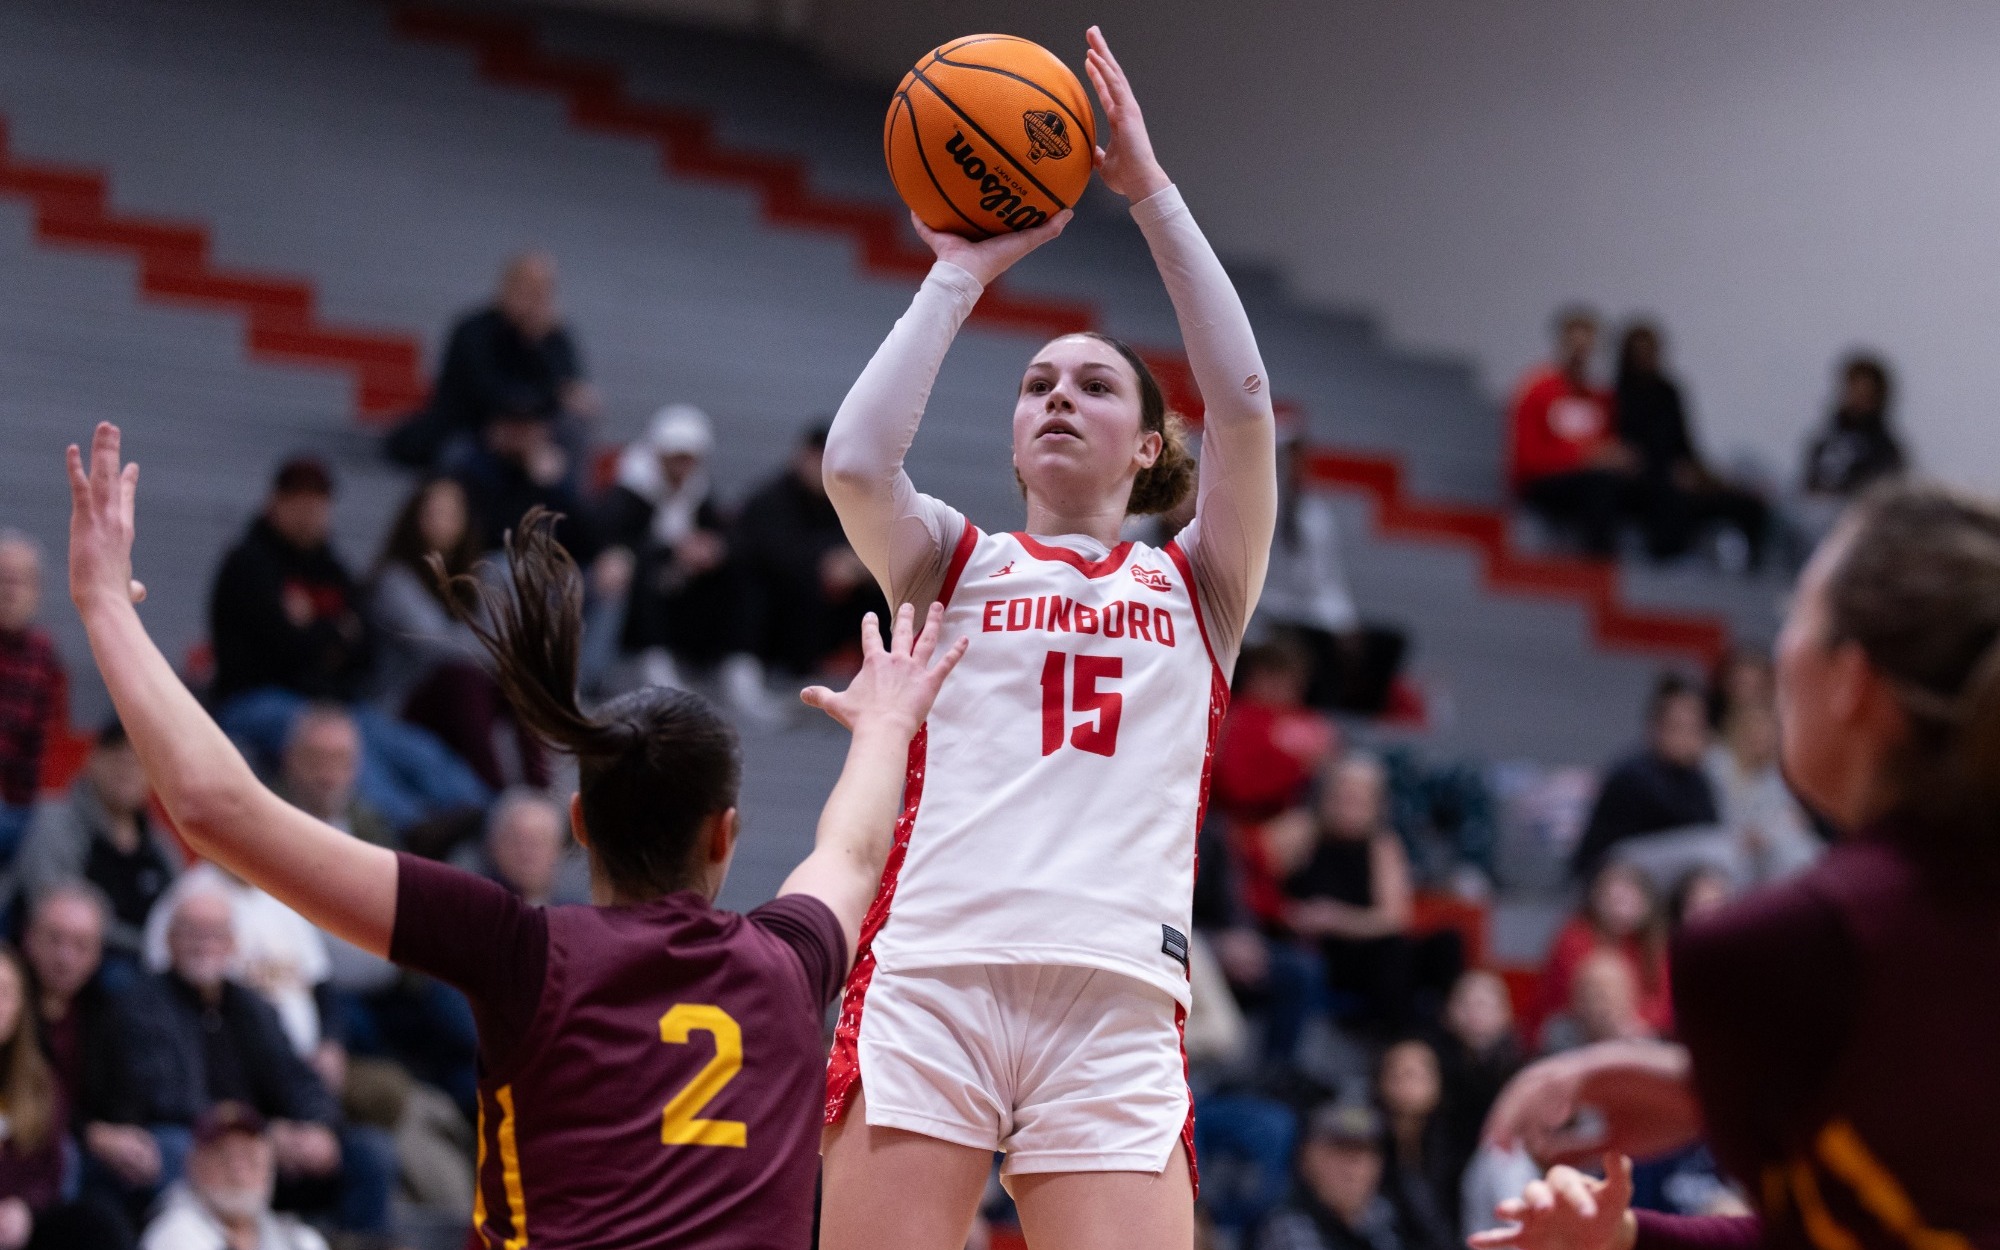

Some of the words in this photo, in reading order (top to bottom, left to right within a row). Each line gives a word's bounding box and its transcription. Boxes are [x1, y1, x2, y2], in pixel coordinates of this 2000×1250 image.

[1024, 113, 1071, 155] CHAMPIONSHIP
[945, 130, 1047, 230] Wilson
[993, 166, 1011, 182] NXT
[1011, 181, 1028, 196] EVO
[982, 595, 1176, 648] EDINBORO
[1040, 650, 1123, 758] 15
[658, 1003, 747, 1148] 2
